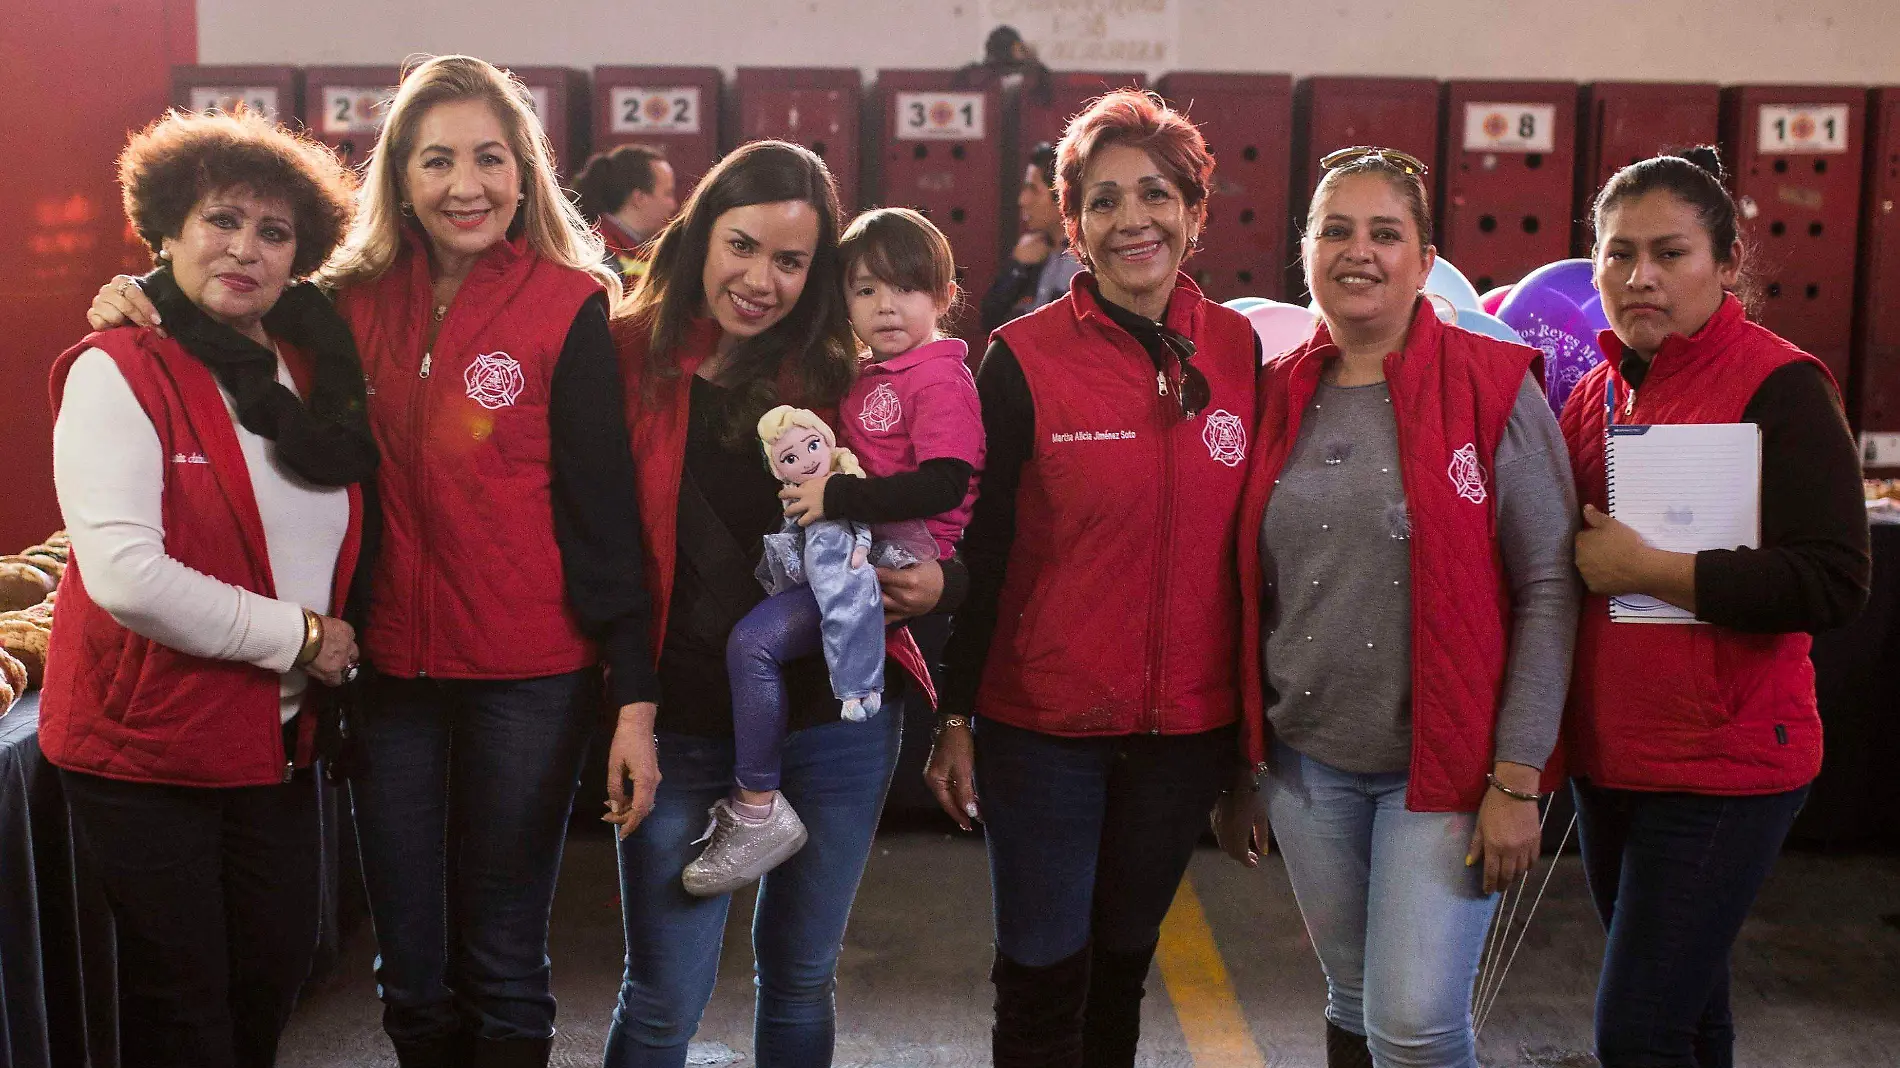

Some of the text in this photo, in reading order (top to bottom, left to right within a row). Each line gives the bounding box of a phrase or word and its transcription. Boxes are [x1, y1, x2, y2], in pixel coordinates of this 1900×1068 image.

[336, 98, 350, 122] 2
[623, 97, 691, 123] 2 2
[908, 102, 973, 128] 3 1
[1519, 113, 1535, 138] 8
[1774, 117, 1834, 140] 1 1
[1538, 324, 1580, 347] Reyes
[1580, 344, 1599, 367] Ma
[1052, 429, 1136, 443] Martha Alicia Jiménez Soto
